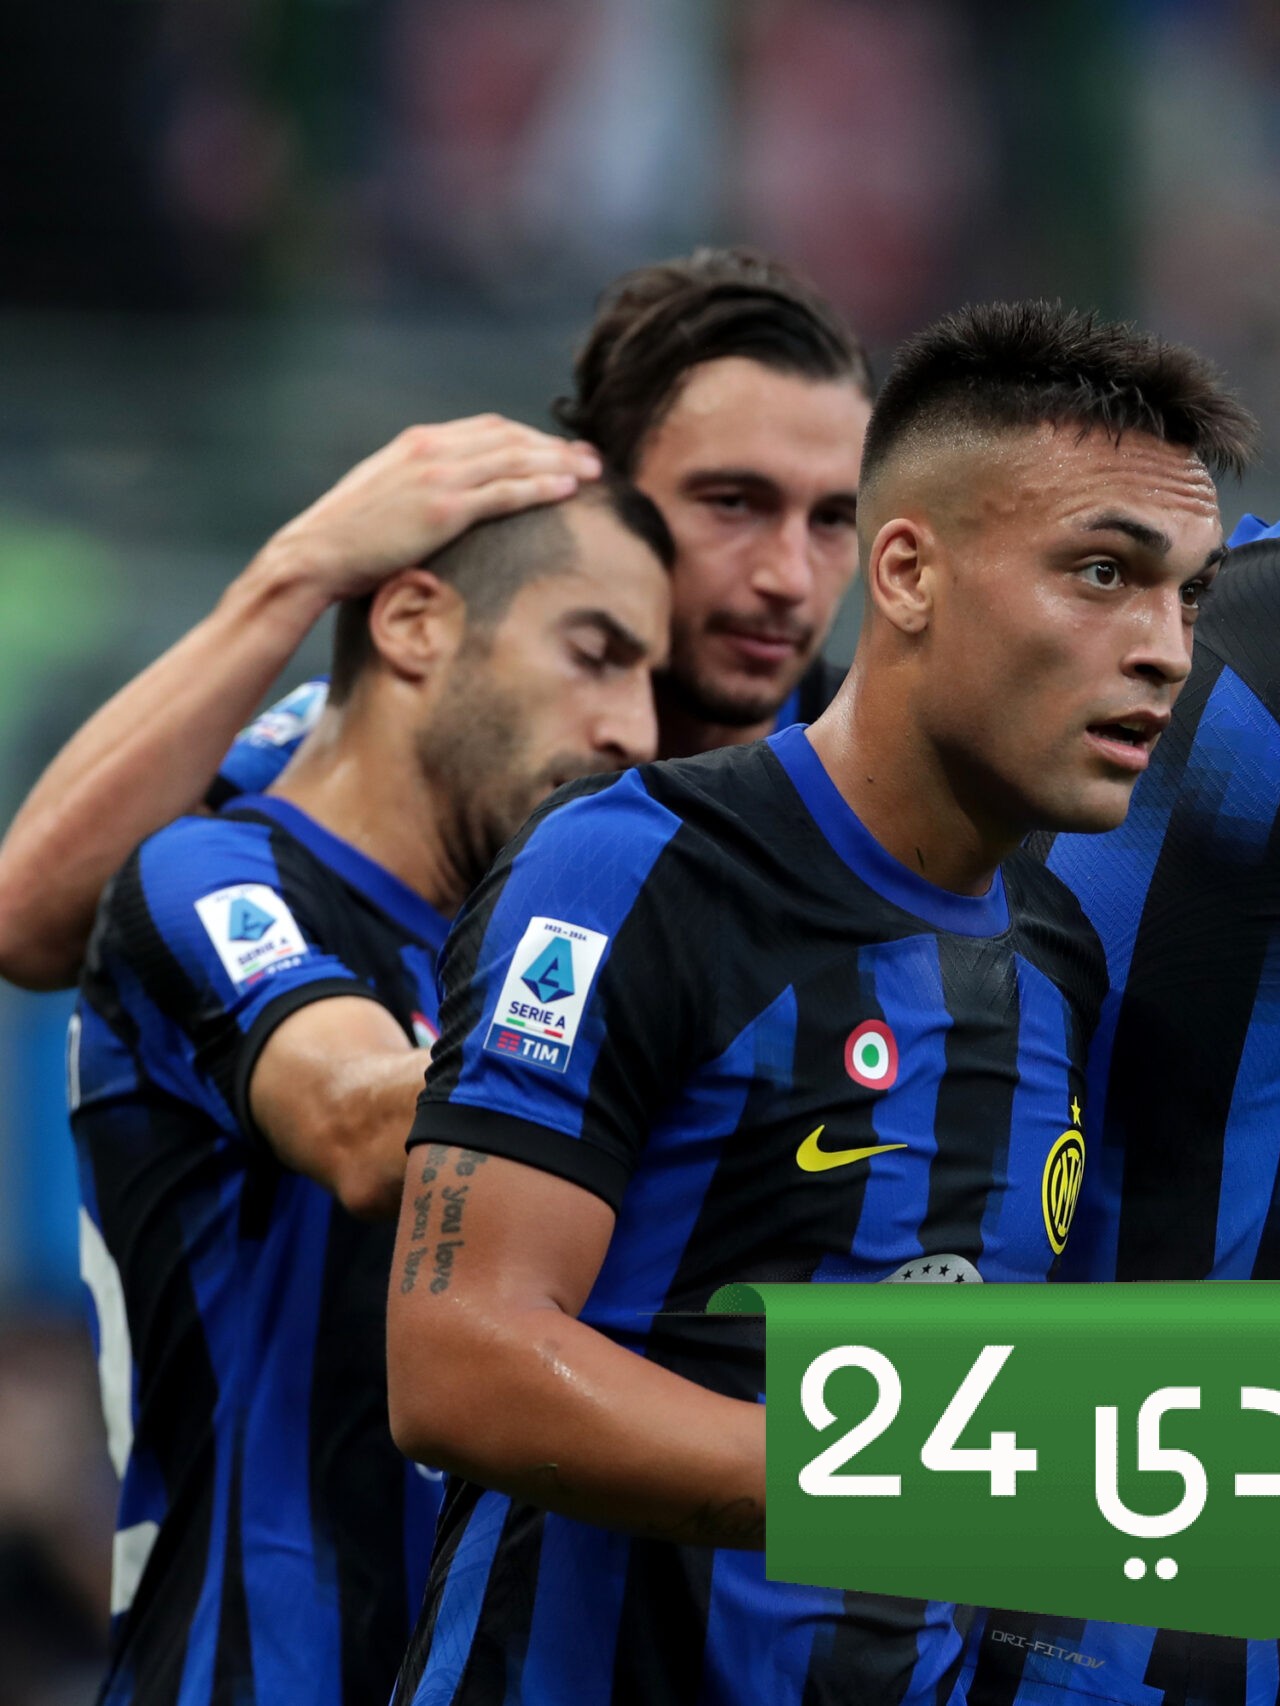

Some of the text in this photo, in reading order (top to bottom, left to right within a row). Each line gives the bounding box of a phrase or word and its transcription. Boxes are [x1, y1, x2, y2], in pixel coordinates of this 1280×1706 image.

[508, 1001, 567, 1030] SERIE A
[522, 1038, 560, 1065] TIM
